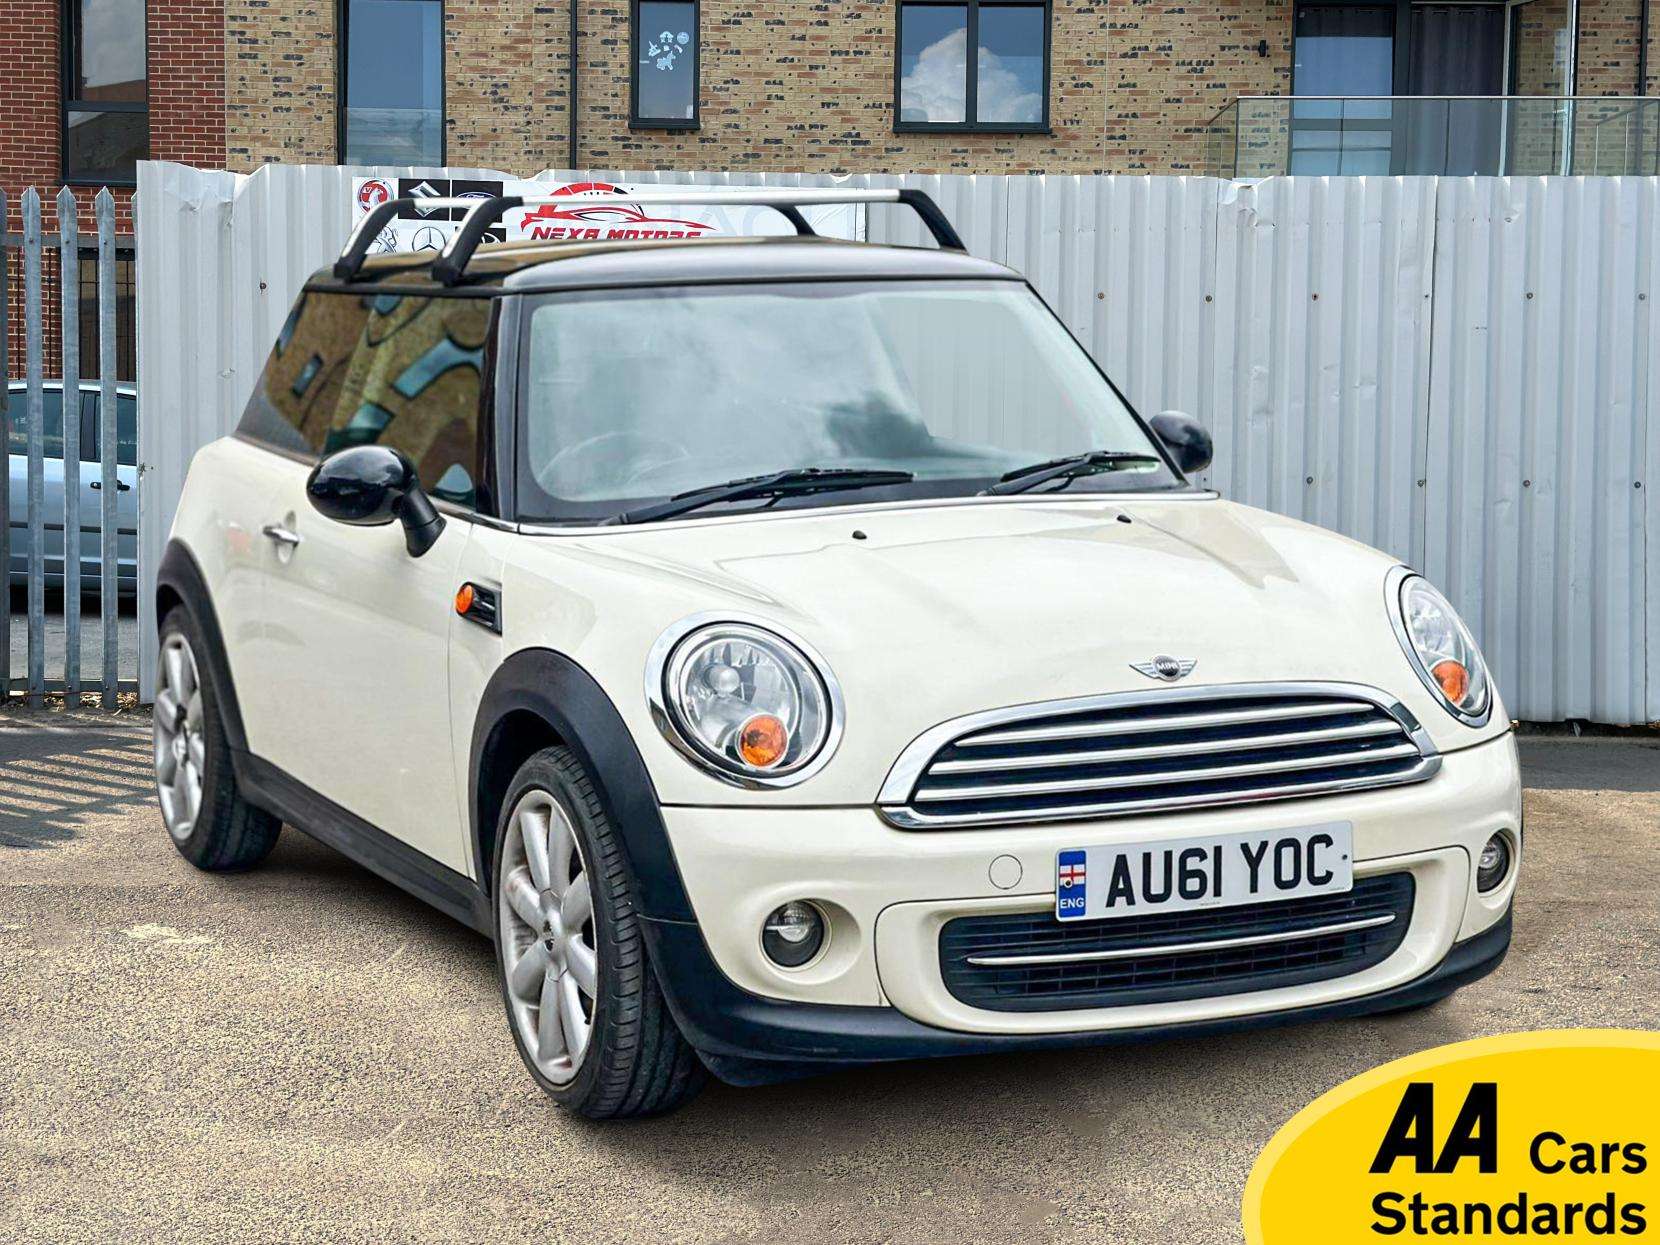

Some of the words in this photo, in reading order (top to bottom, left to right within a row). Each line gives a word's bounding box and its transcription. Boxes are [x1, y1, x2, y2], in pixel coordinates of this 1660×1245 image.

[531, 226, 601, 240] NEXA
[1105, 845, 1223, 908] AU61
[1240, 833, 1335, 894] YOC
[1060, 897, 1085, 910] ENG
